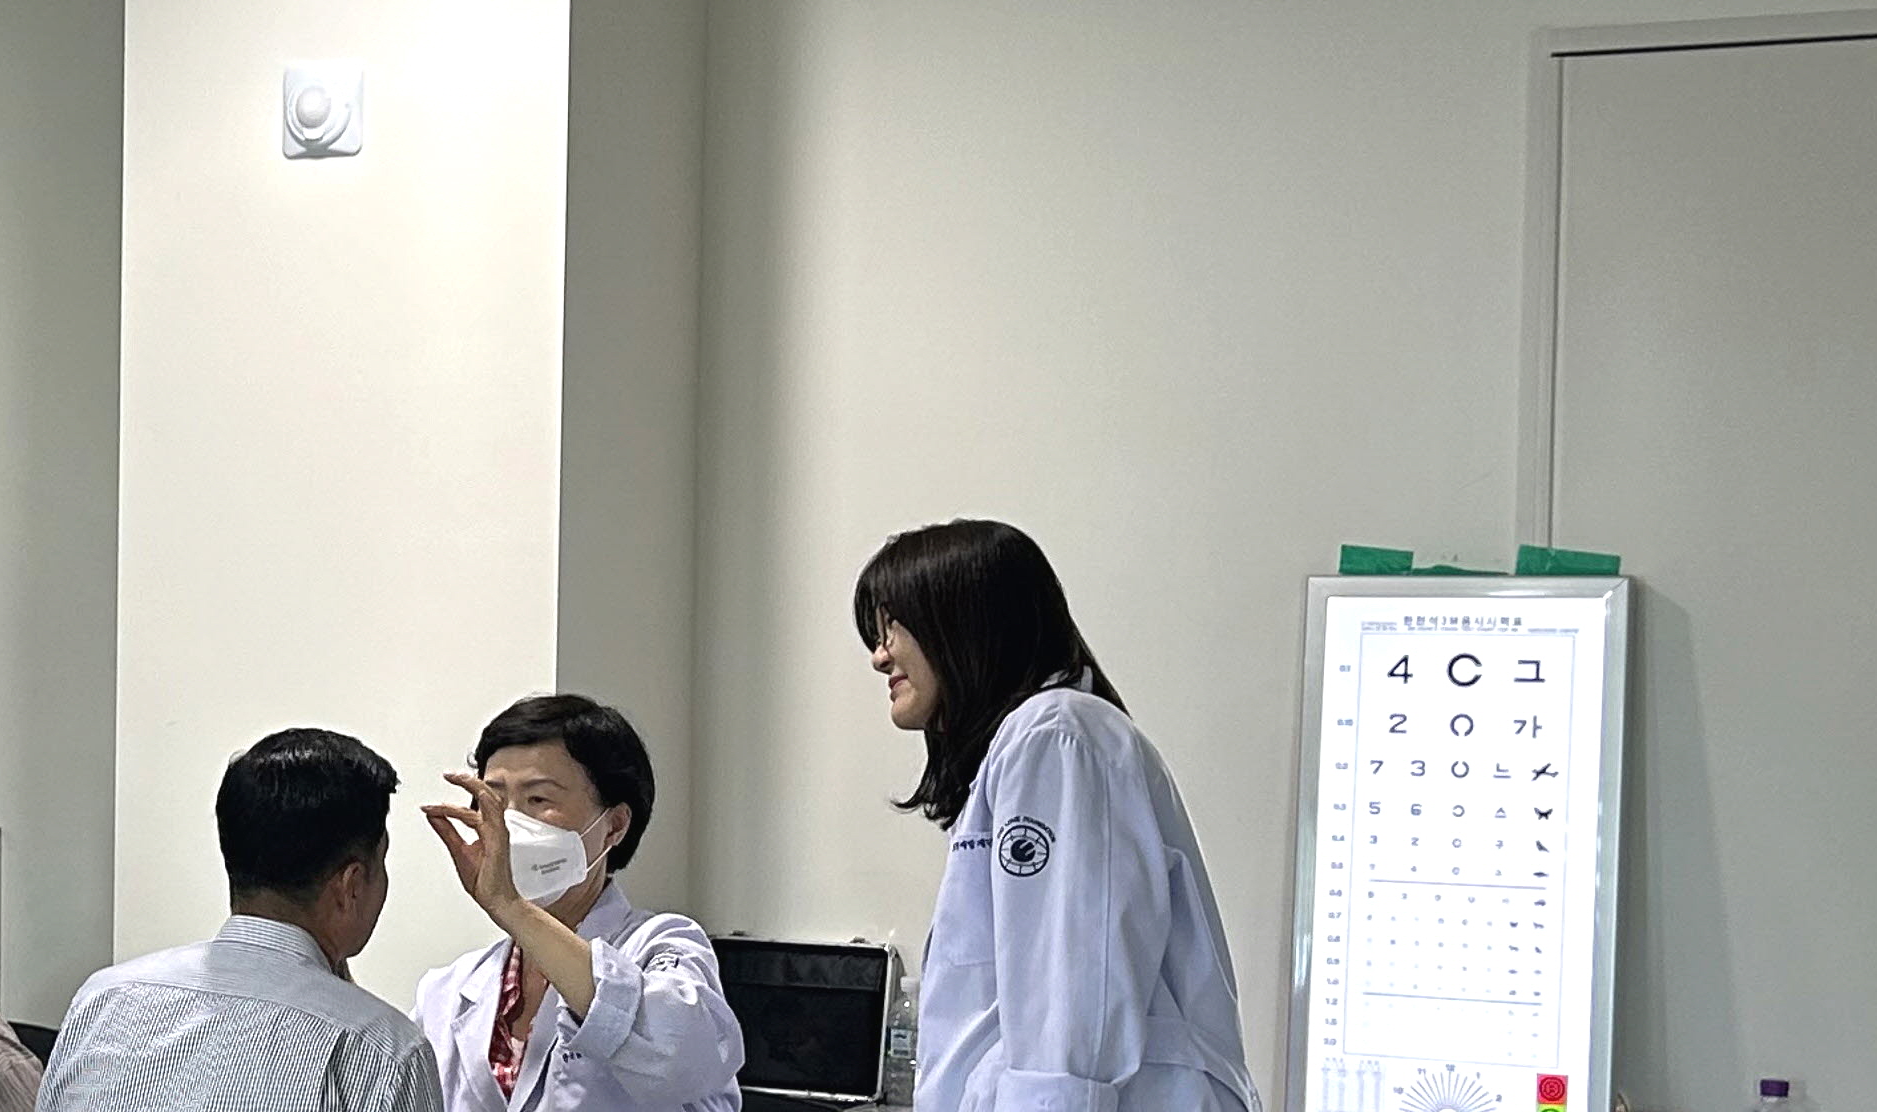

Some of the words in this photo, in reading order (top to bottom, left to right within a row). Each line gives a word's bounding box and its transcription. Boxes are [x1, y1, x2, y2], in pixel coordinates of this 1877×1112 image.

[1388, 655, 1413, 684] 4
[1514, 660, 1545, 683] 그
[1389, 714, 1407, 733] 2
[1514, 716, 1542, 738] 가
[1370, 760, 1383, 774] 7
[1411, 760, 1425, 776] 3
[1369, 802, 1381, 814] 5
[1411, 804, 1422, 816] 6
